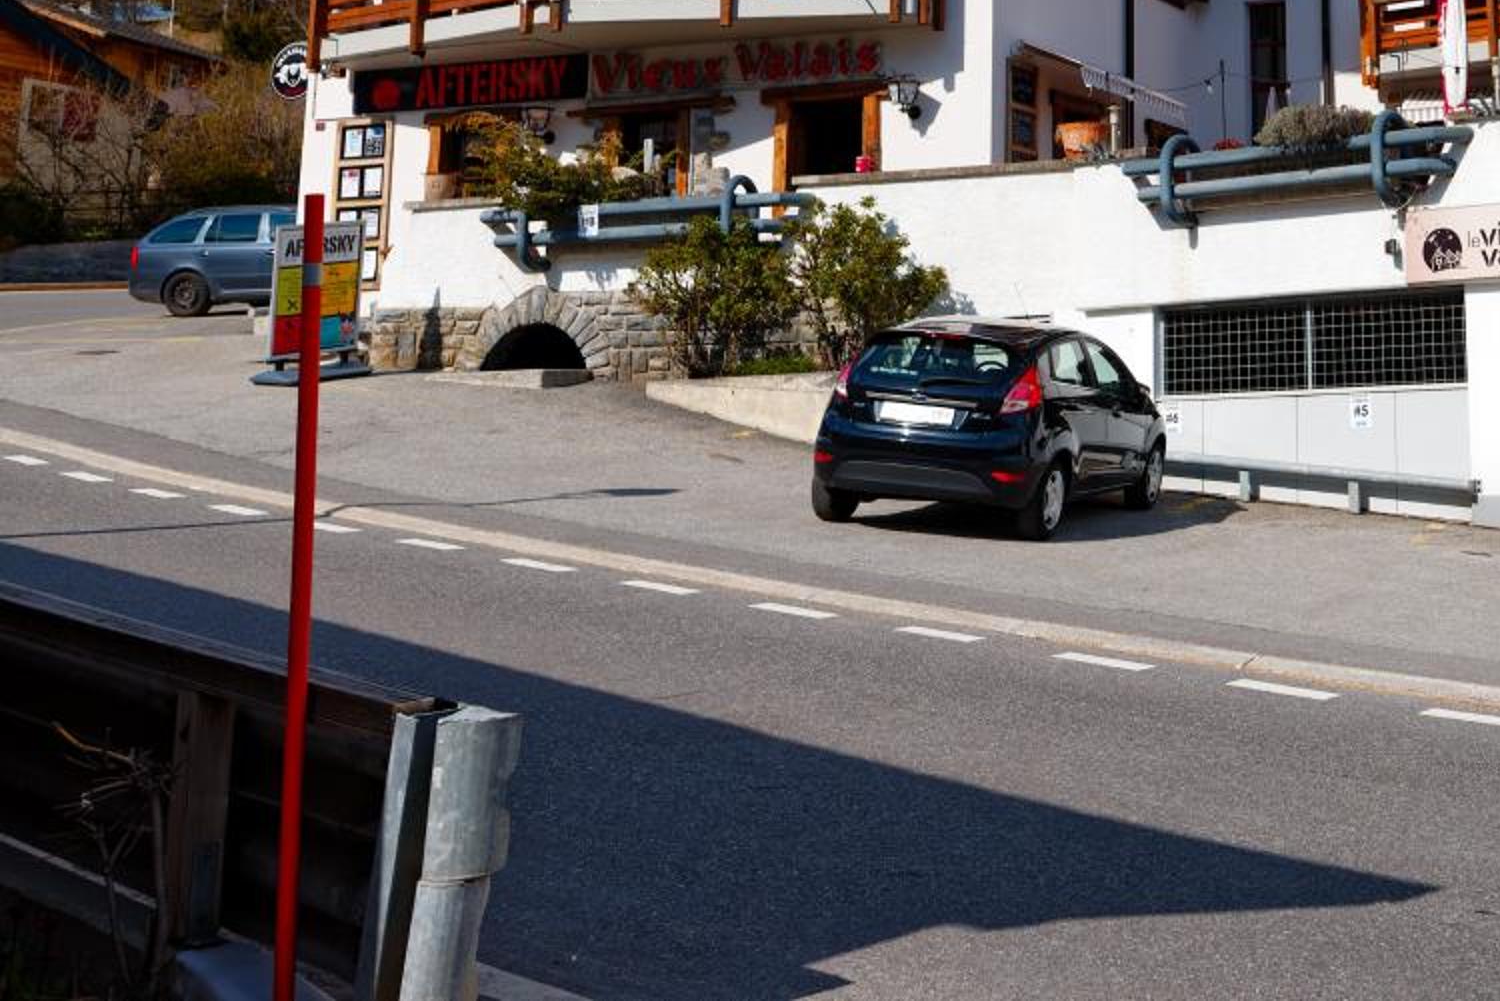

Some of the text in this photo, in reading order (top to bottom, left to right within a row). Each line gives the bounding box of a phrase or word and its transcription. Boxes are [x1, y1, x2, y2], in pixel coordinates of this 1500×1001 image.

[735, 38, 879, 81] Valais
[416, 57, 566, 108] AFTERSKY
[285, 235, 356, 258] AFRSKY
[1353, 404, 1369, 419] #5
